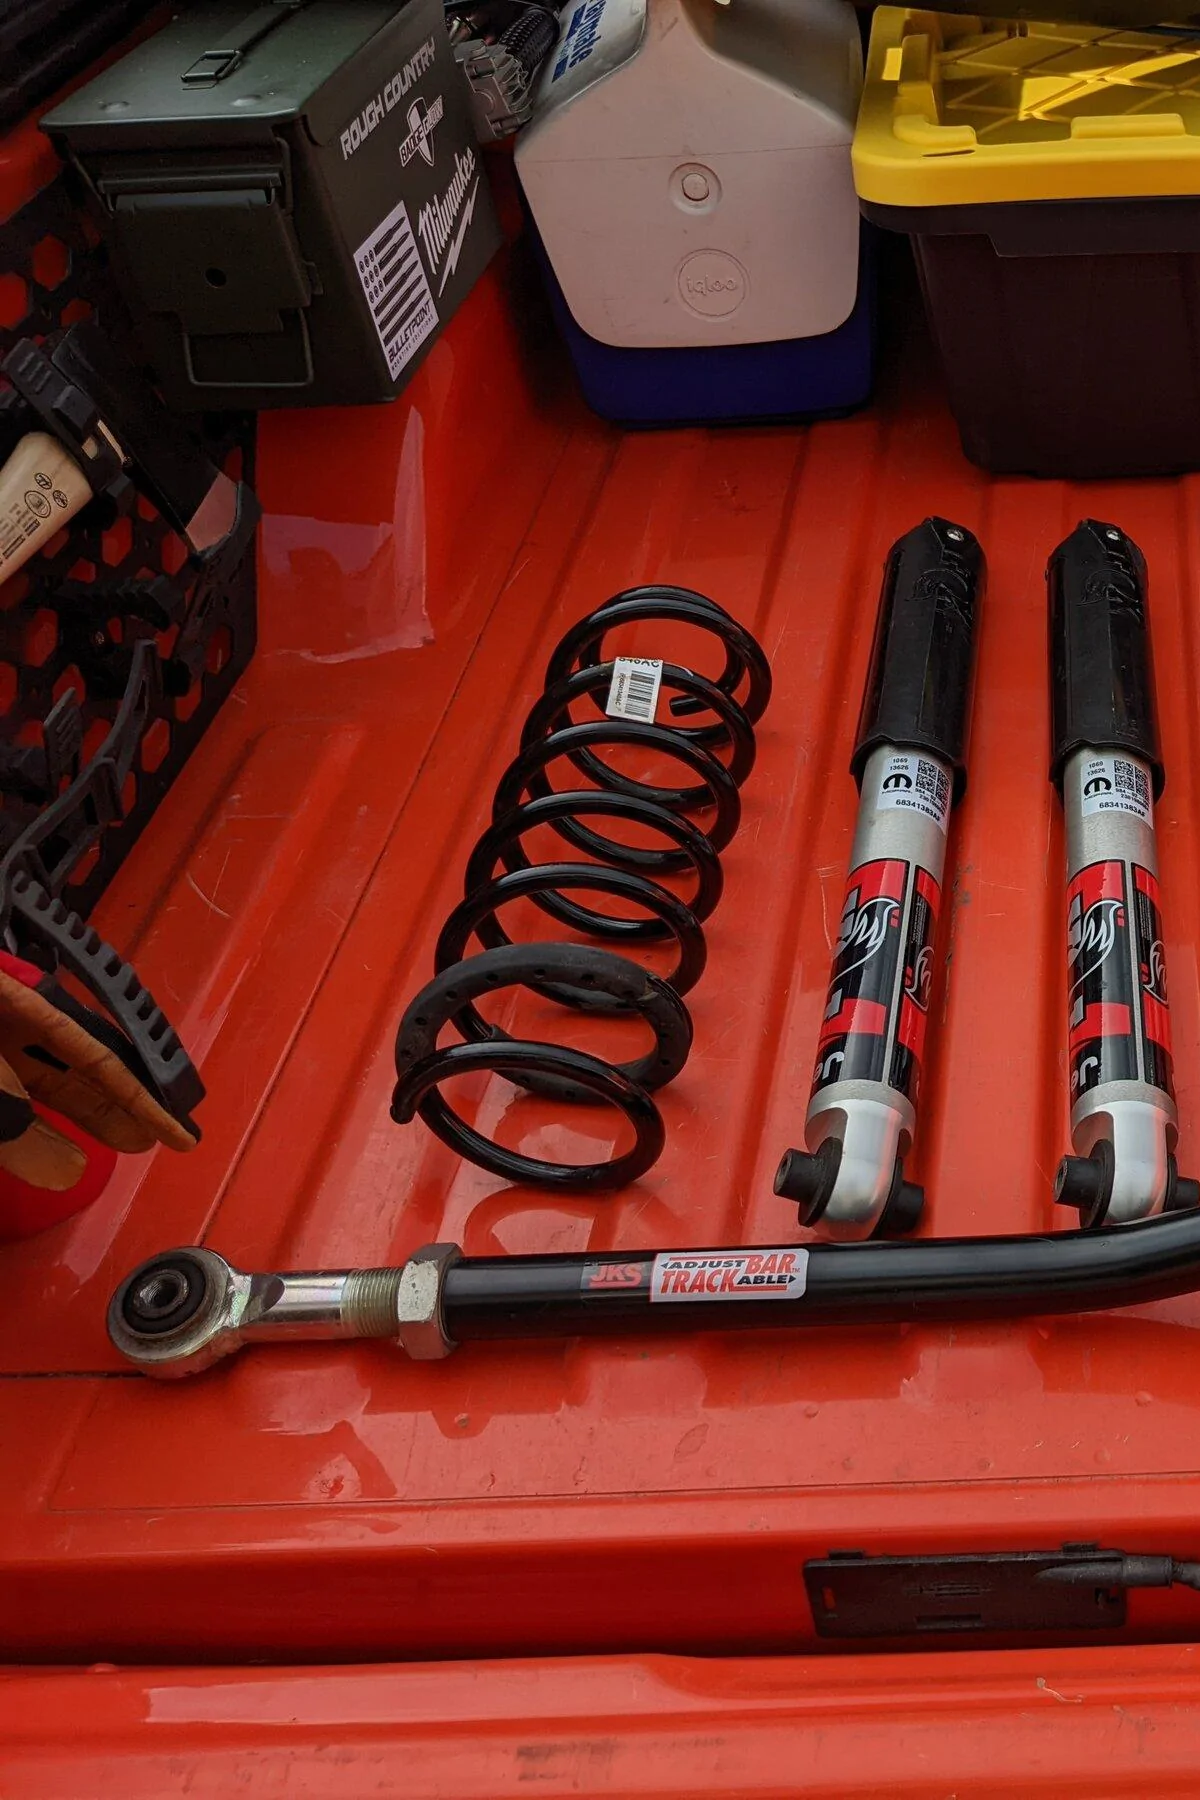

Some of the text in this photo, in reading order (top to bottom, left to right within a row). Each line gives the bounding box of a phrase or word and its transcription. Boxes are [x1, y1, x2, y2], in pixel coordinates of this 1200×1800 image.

[340, 93, 385, 160] ROUGH
[384, 36, 436, 112] COUNTRY
[418, 146, 476, 275] Milwaukee
[686, 273, 738, 297] igloo
[388, 301, 431, 363] BULLETPOINT
[589, 1264, 642, 1288] JKS
[665, 1259, 747, 1269] ADJUST
[744, 1253, 795, 1275] BAR
[660, 1268, 737, 1294] TRACK
[737, 1274, 789, 1285] ABLE
